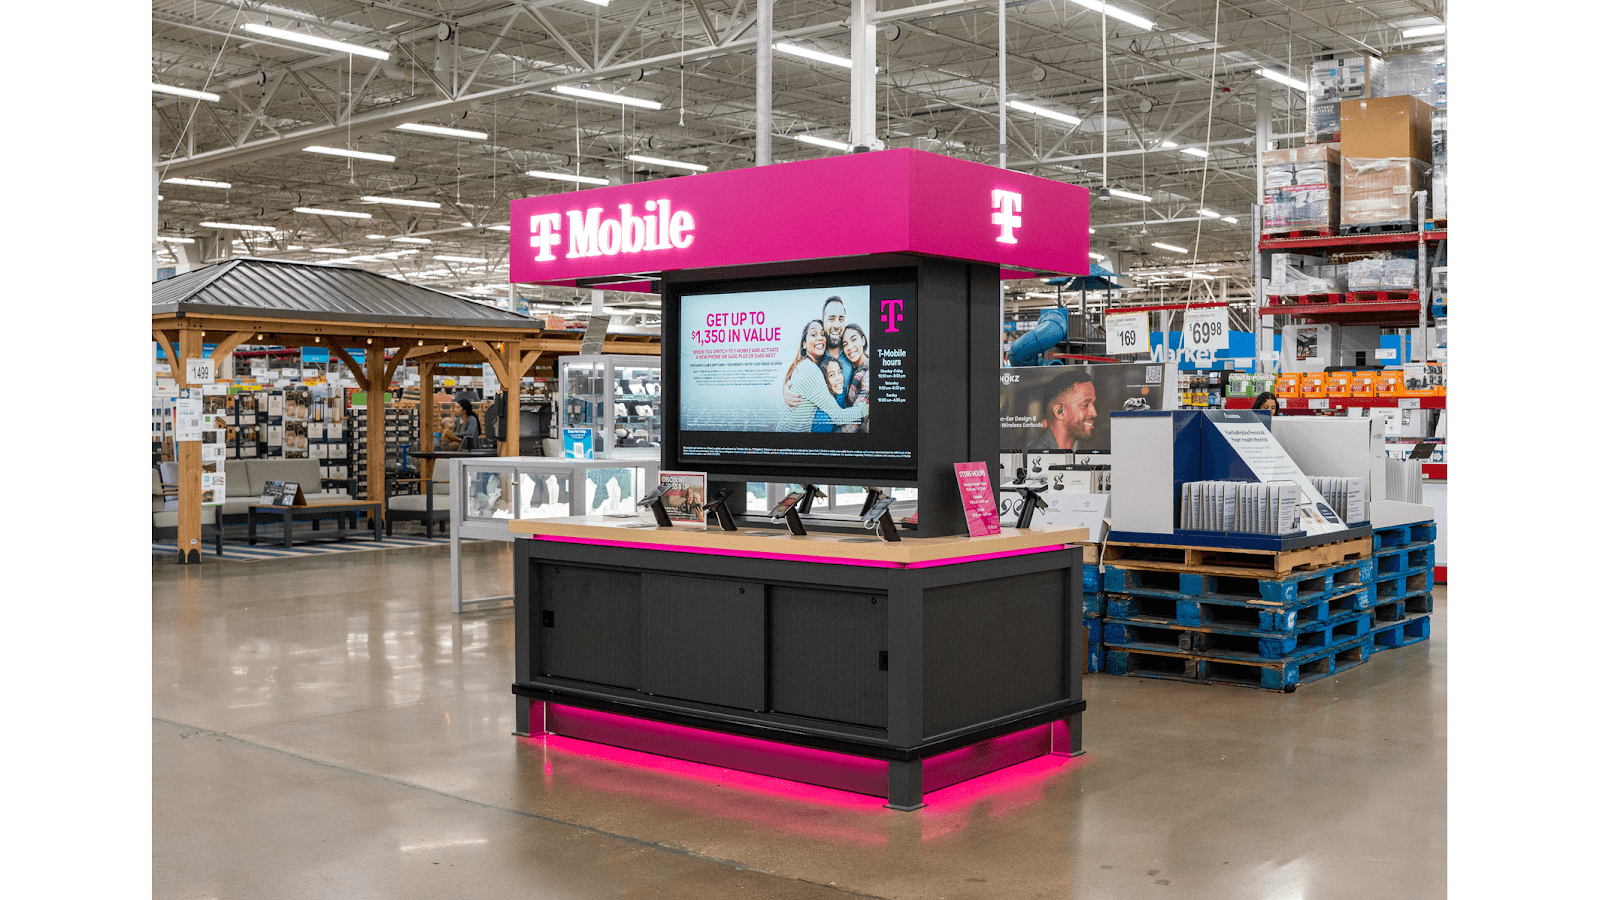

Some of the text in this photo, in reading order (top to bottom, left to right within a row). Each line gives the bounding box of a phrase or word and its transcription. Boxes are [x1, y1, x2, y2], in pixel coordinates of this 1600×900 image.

[991, 188, 1022, 244] T
[566, 199, 695, 258] Mobile
[706, 311, 765, 327] GET UP TO
[880, 300, 904, 332] T
[691, 327, 781, 346] $1,350 IN VALUE
[878, 349, 906, 357] T-Mobile
[1150, 344, 1217, 362] Market
